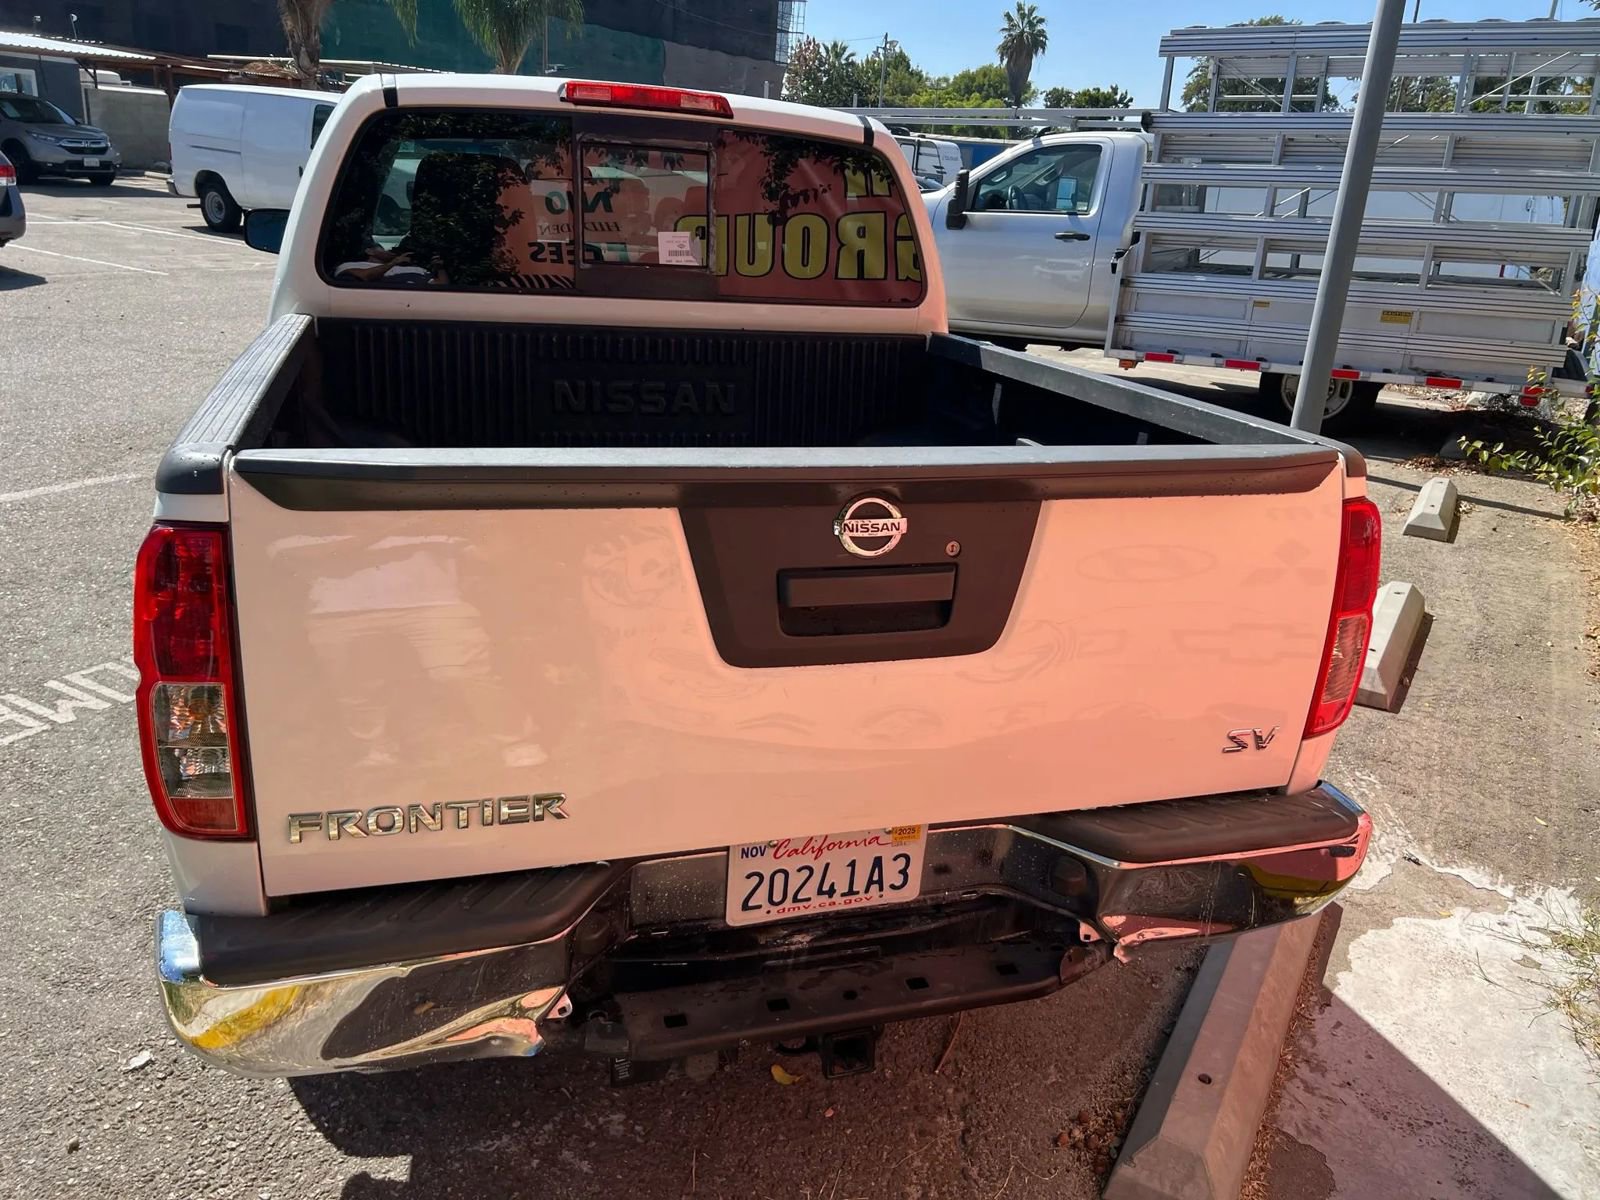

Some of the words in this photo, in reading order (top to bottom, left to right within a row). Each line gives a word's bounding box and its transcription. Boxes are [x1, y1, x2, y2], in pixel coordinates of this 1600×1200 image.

[553, 379, 736, 414] NISSAN
[843, 521, 901, 534] NISSAN
[1222, 725, 1281, 754] SV
[287, 792, 570, 844] FRONTIER
[740, 845, 767, 860] NOV
[772, 834, 893, 861] California
[897, 826, 916, 836] 2025
[741, 852, 912, 912] 20241A3
[776, 895, 874, 915] dmv.ca.gov
